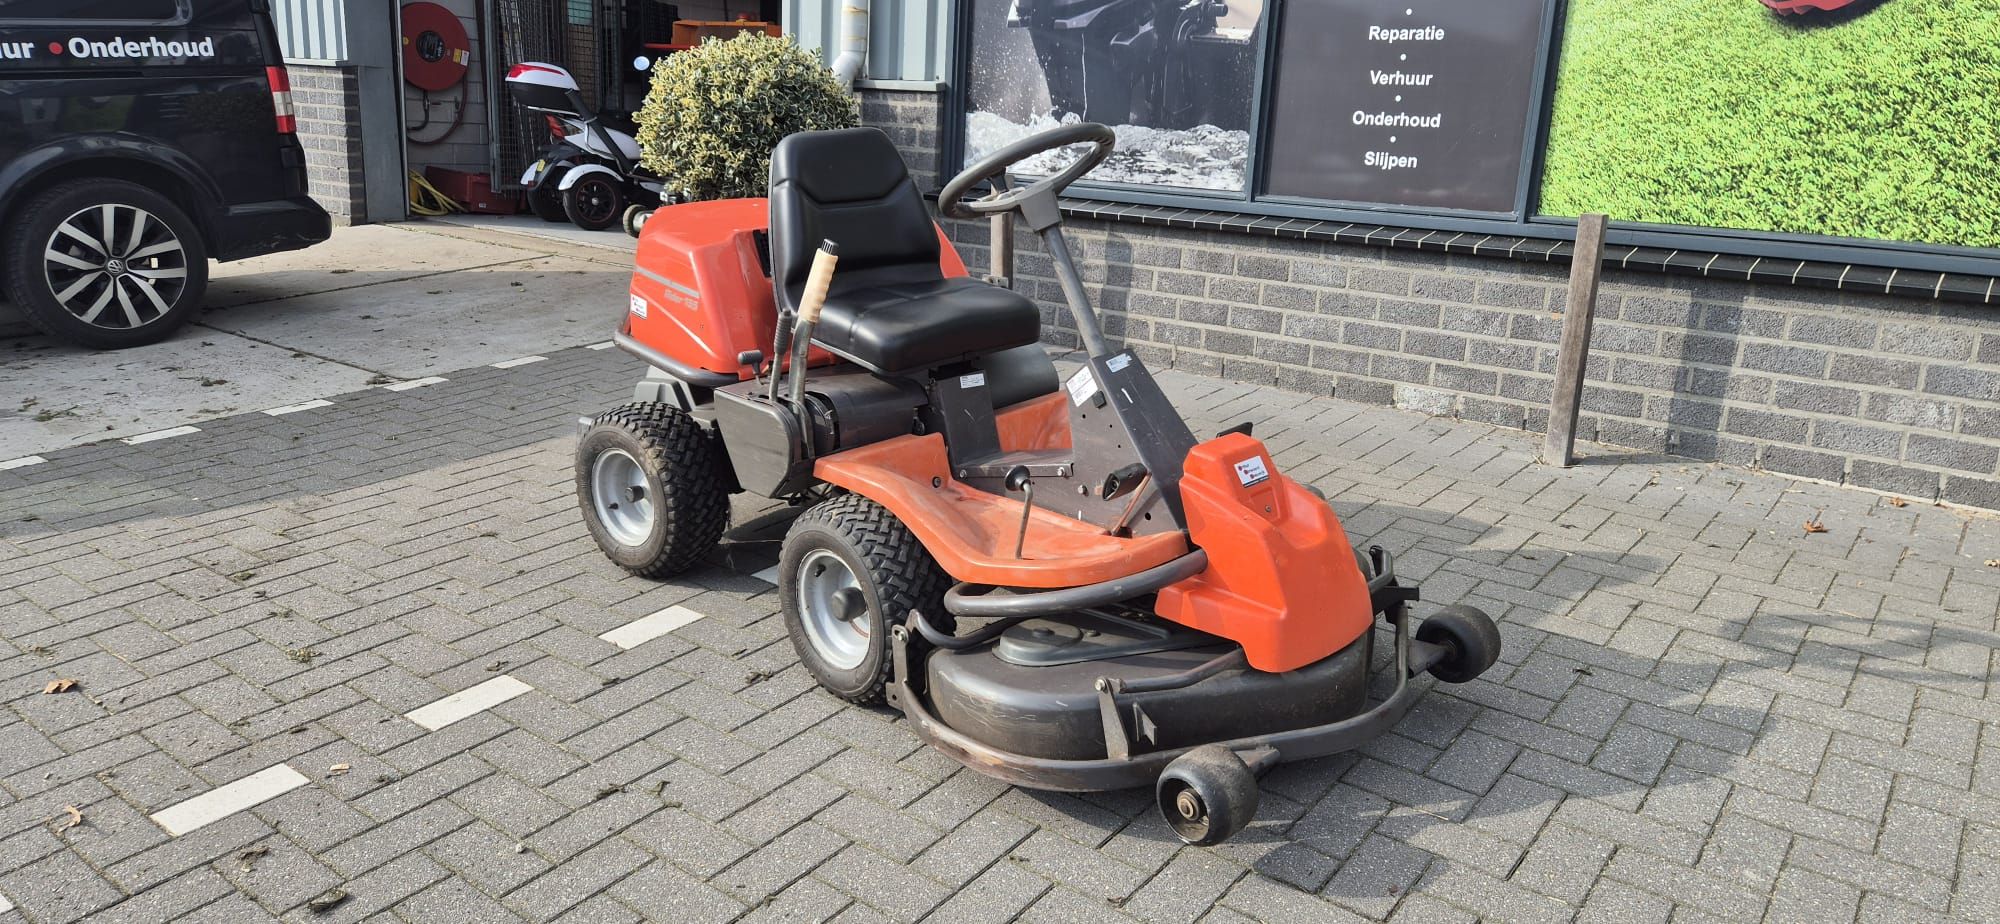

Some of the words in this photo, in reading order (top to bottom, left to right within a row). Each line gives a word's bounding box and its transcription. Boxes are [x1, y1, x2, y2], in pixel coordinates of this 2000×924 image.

[1369, 25, 1444, 43] Reparatie
[0, 43, 34, 58] ur
[69, 37, 214, 57] Onderhoud
[1370, 70, 1433, 85] Verhuur
[1353, 111, 1441, 127] Onderhoud
[1364, 151, 1417, 170] Slijpen
